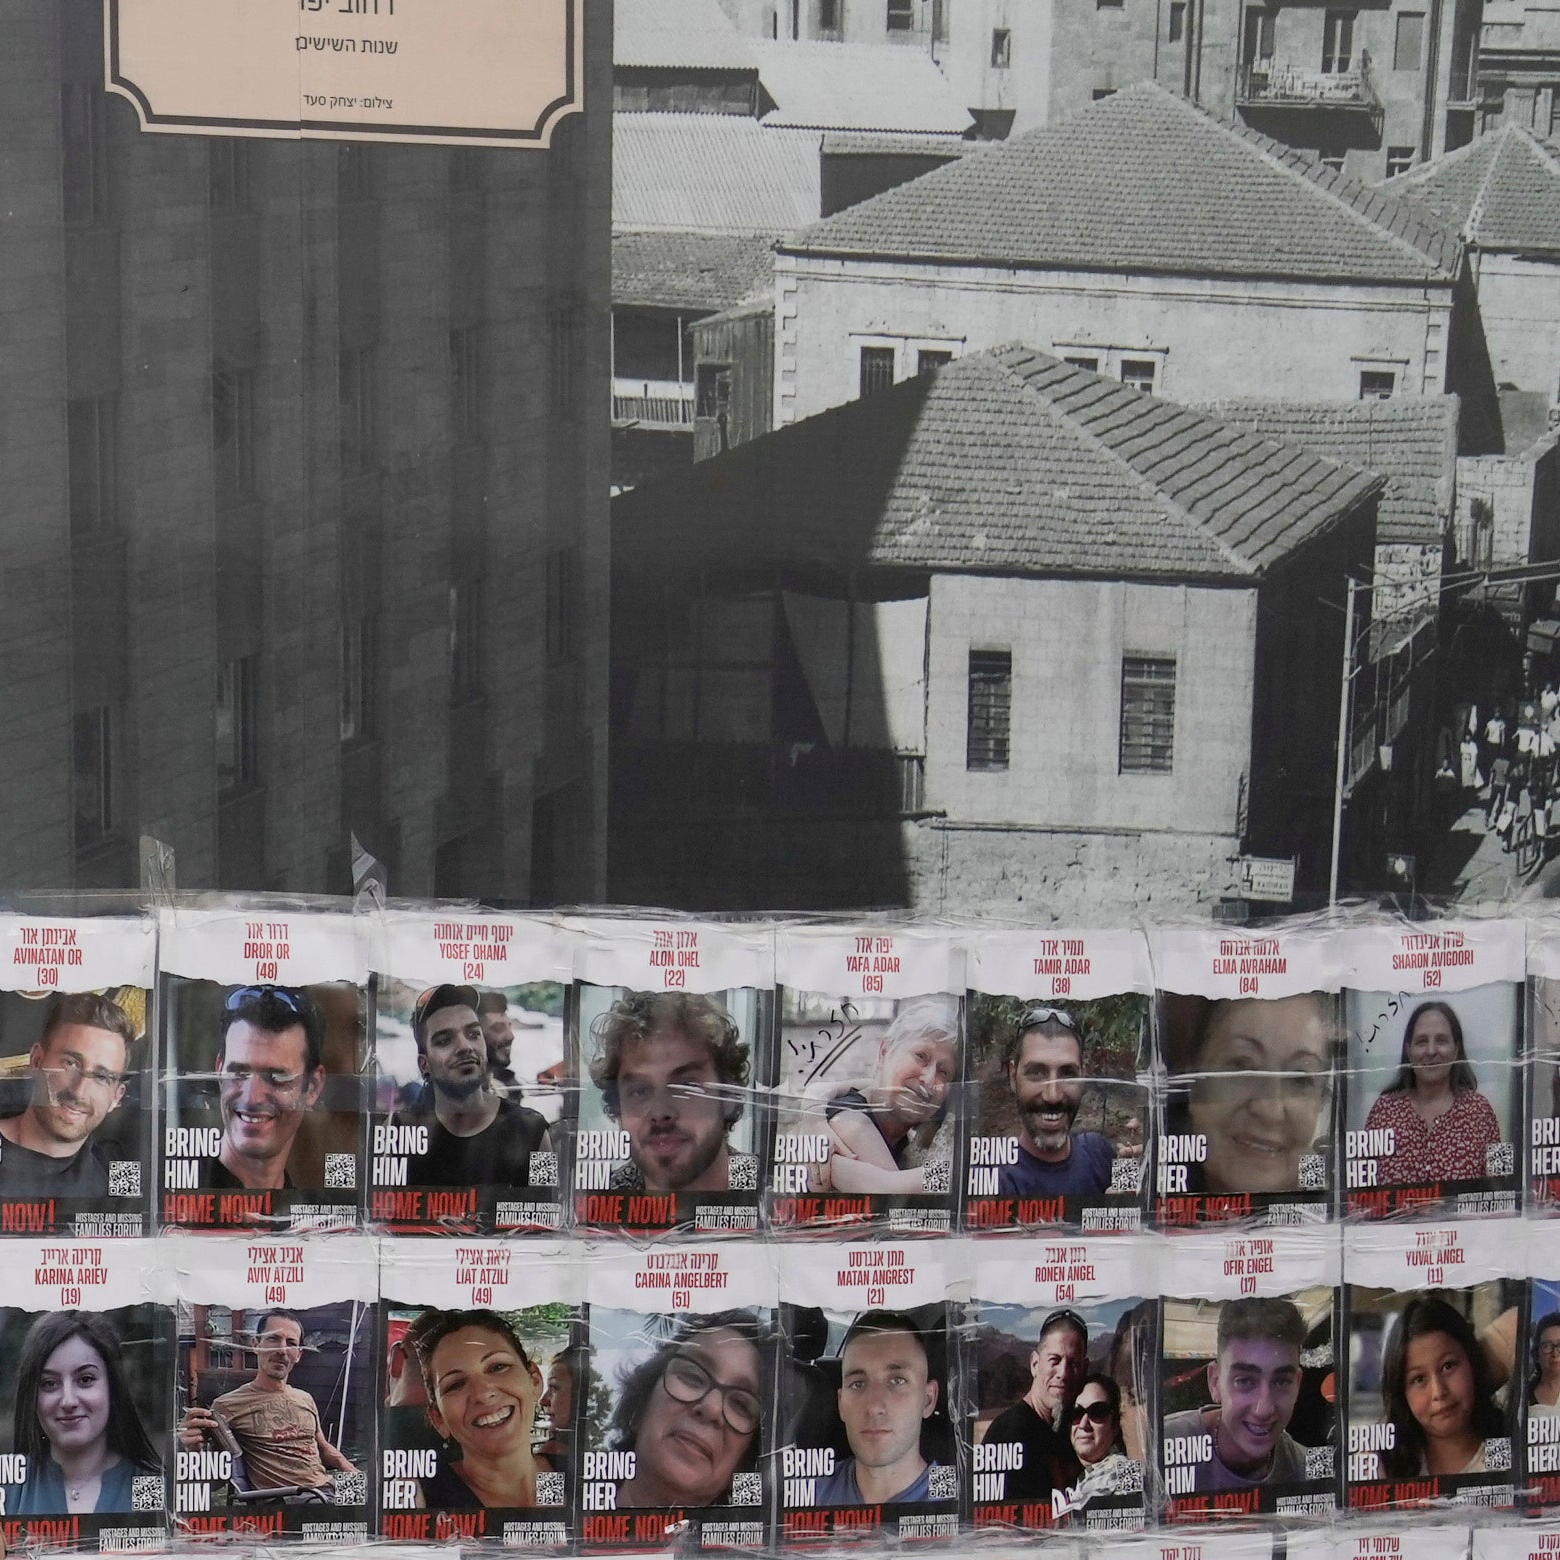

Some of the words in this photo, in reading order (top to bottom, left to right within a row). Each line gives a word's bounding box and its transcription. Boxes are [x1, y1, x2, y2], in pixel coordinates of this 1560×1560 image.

[295, 36, 356, 52] השישים
[361, 40, 398, 54] שנות
[303, 94, 327, 107] סעד
[330, 96, 357, 110] יצחק
[360, 96, 393, 109] צילום:
[13, 945, 65, 965] AVINATAN
[67, 948, 83, 965] OR
[244, 939, 274, 960] DROR
[275, 942, 290, 960] OR
[440, 942, 470, 960] YOSEF
[473, 942, 508, 960] OHANA
[649, 947, 676, 967] ALON
[677, 950, 701, 968] OHEL
[1393, 952, 1431, 970] SHARON
[1431, 947, 1475, 967] AVIGDORI
[847, 956, 871, 973] YAFA
[873, 955, 901, 974] ADAR
[1034, 958, 1063, 975] TAMIR
[1064, 958, 1091, 975] ADAR
[1212, 958, 1238, 975] ELMA
[1240, 958, 1288, 974] AVRAHAM
[37, 967, 60, 986] (30)
[1224, 1258, 1245, 1277] OFIR
[1247, 1255, 1274, 1274] ENGEL
[1406, 1249, 1435, 1267] YUVAL
[1437, 1248, 1465, 1264] ANGEL
[35, 1268, 75, 1285] KARINA
[77, 1265, 108, 1285] ARIEV
[247, 1266, 272, 1283] AVIV
[273, 1266, 305, 1283] ATZILI
[456, 1265, 478, 1285] LIAT
[479, 1266, 509, 1285] ATZILI
[635, 1271, 672, 1289] CARINA
[674, 1269, 729, 1289] ANGELBERT
[837, 1270, 871, 1286] MATAN
[872, 1267, 915, 1285] ANGREST
[1035, 1265, 1066, 1283] RONEN
[1068, 1263, 1096, 1281] ANGEL
[673, 1290, 691, 1308] (51)
[176, 1450, 232, 1480] BRING
[175, 1482, 210, 1513] HIM
